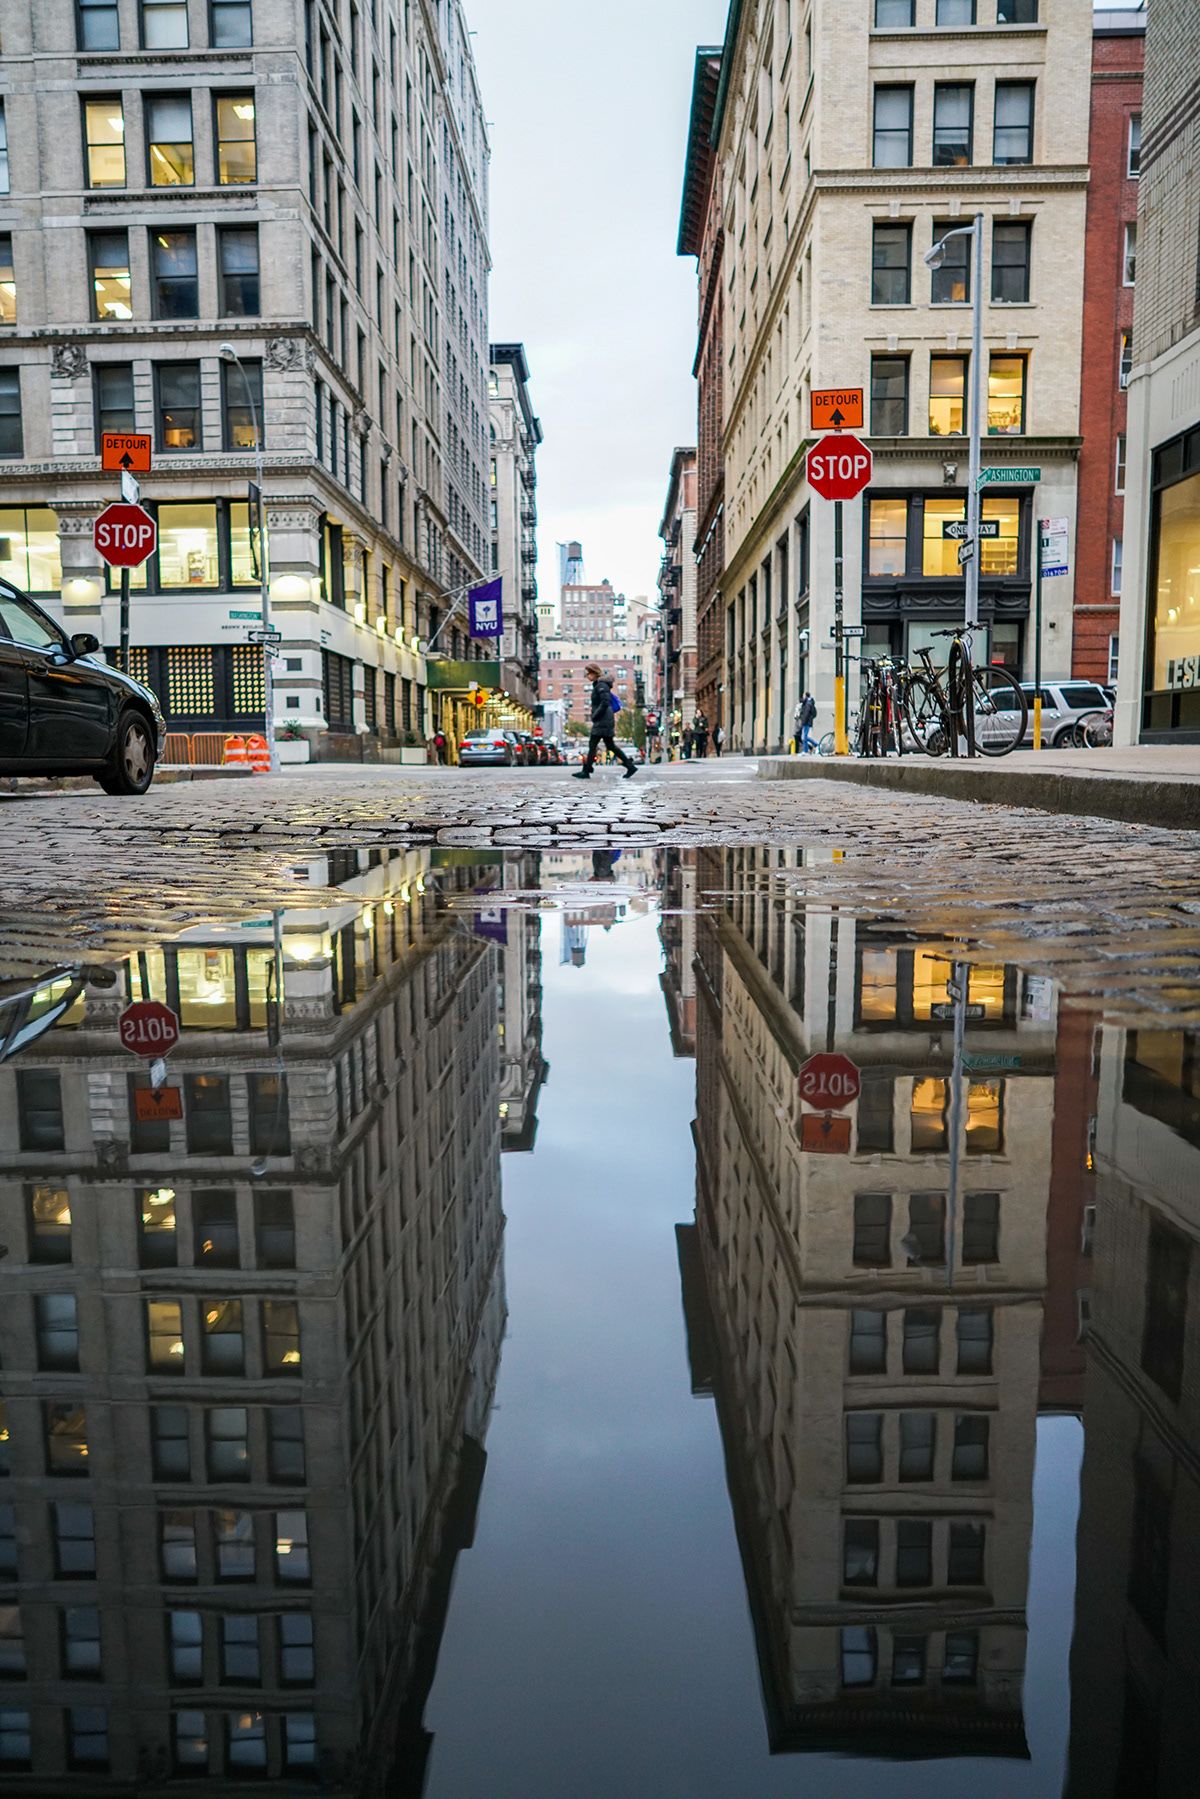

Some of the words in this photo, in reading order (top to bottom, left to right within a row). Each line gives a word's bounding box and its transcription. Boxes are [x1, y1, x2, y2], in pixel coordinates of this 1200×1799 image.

[815, 394, 859, 406] DETOUR
[106, 439, 147, 449] DETOUR
[810, 455, 868, 480] STOP
[991, 469, 1034, 481] ASHINGTON
[97, 523, 152, 548] STOP
[950, 525, 966, 534] ONE
[979, 525, 992, 533] AY
[476, 621, 498, 631] NYU
